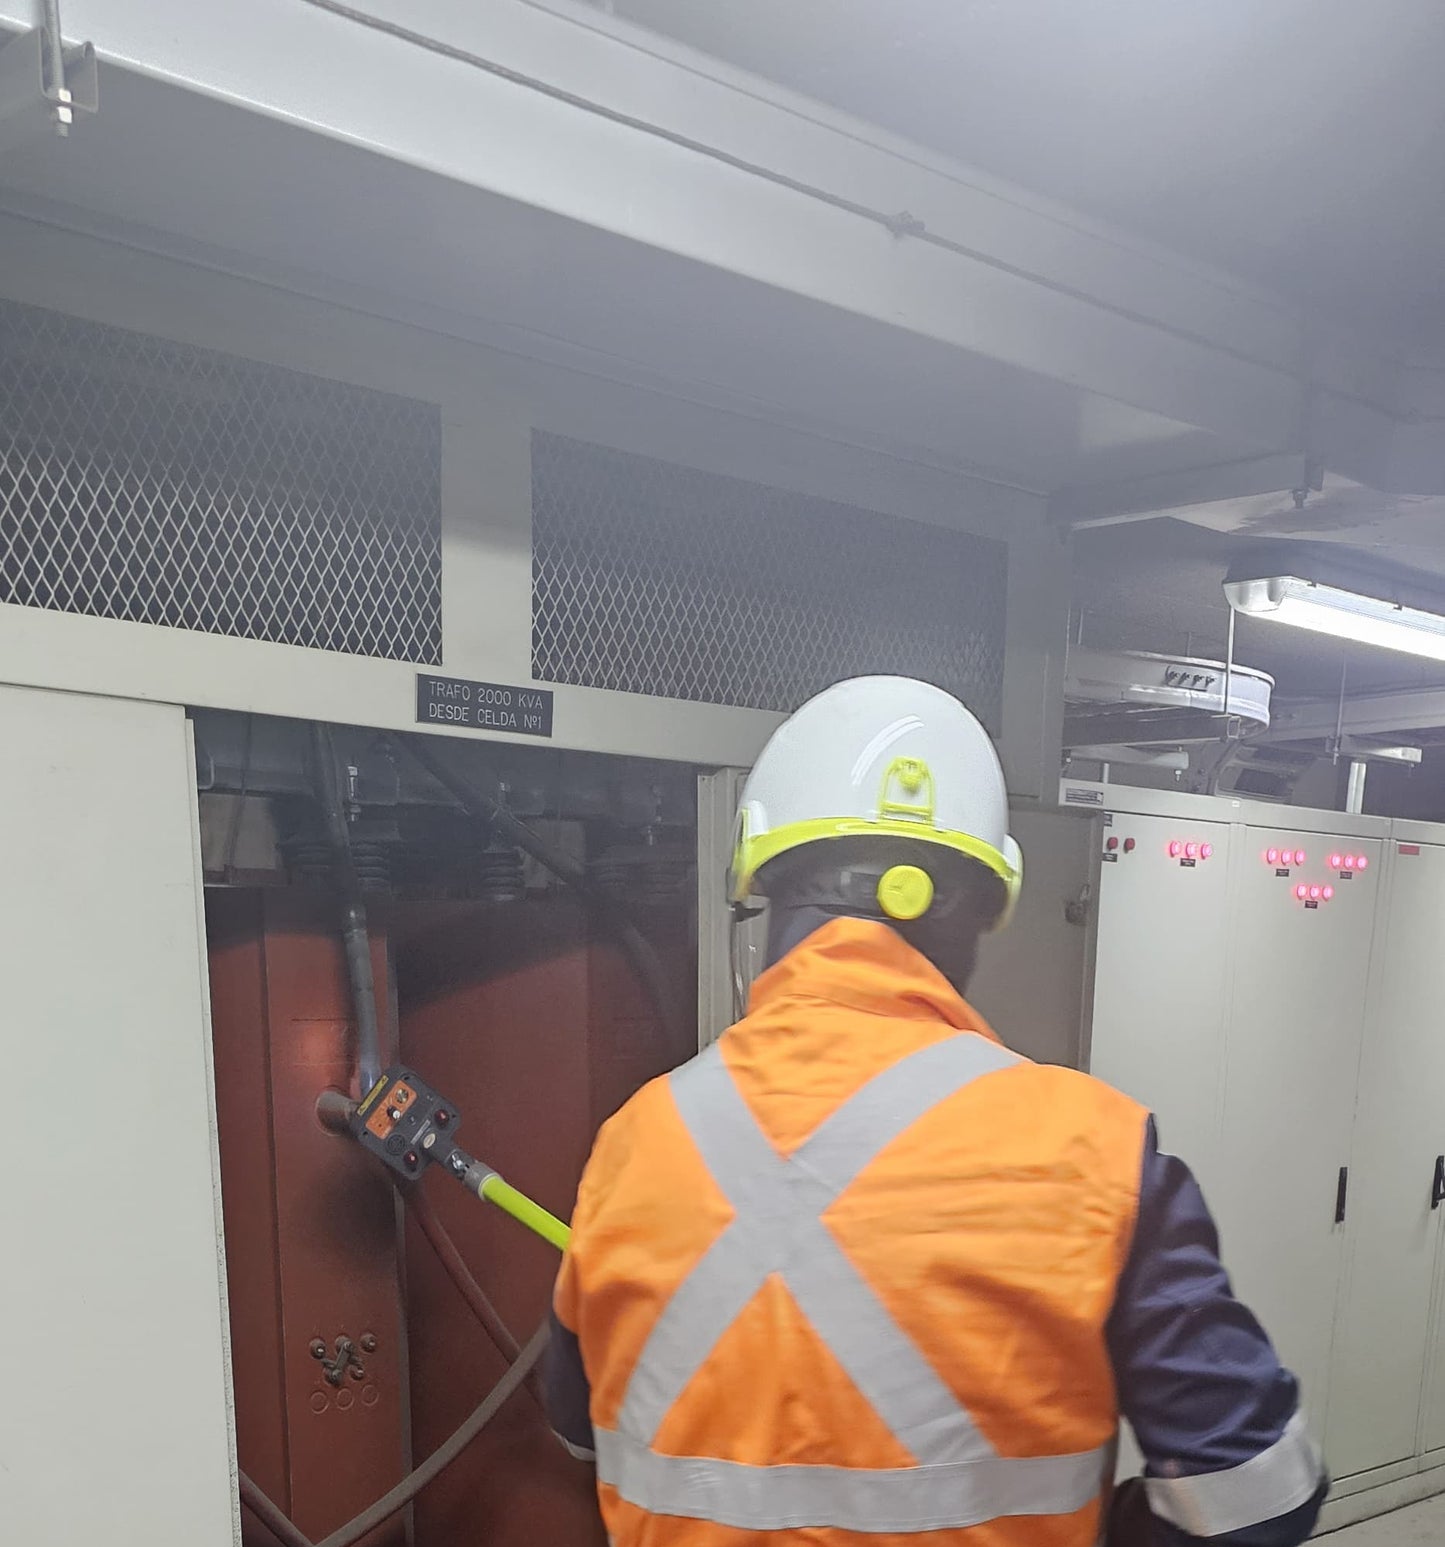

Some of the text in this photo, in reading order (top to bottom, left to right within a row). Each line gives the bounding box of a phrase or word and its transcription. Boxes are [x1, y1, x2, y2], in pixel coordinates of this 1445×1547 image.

[429, 681, 543, 709] TRAFO 2000 KVA
[429, 703, 470, 722] DESDE
[477, 708, 517, 727] CELDA
